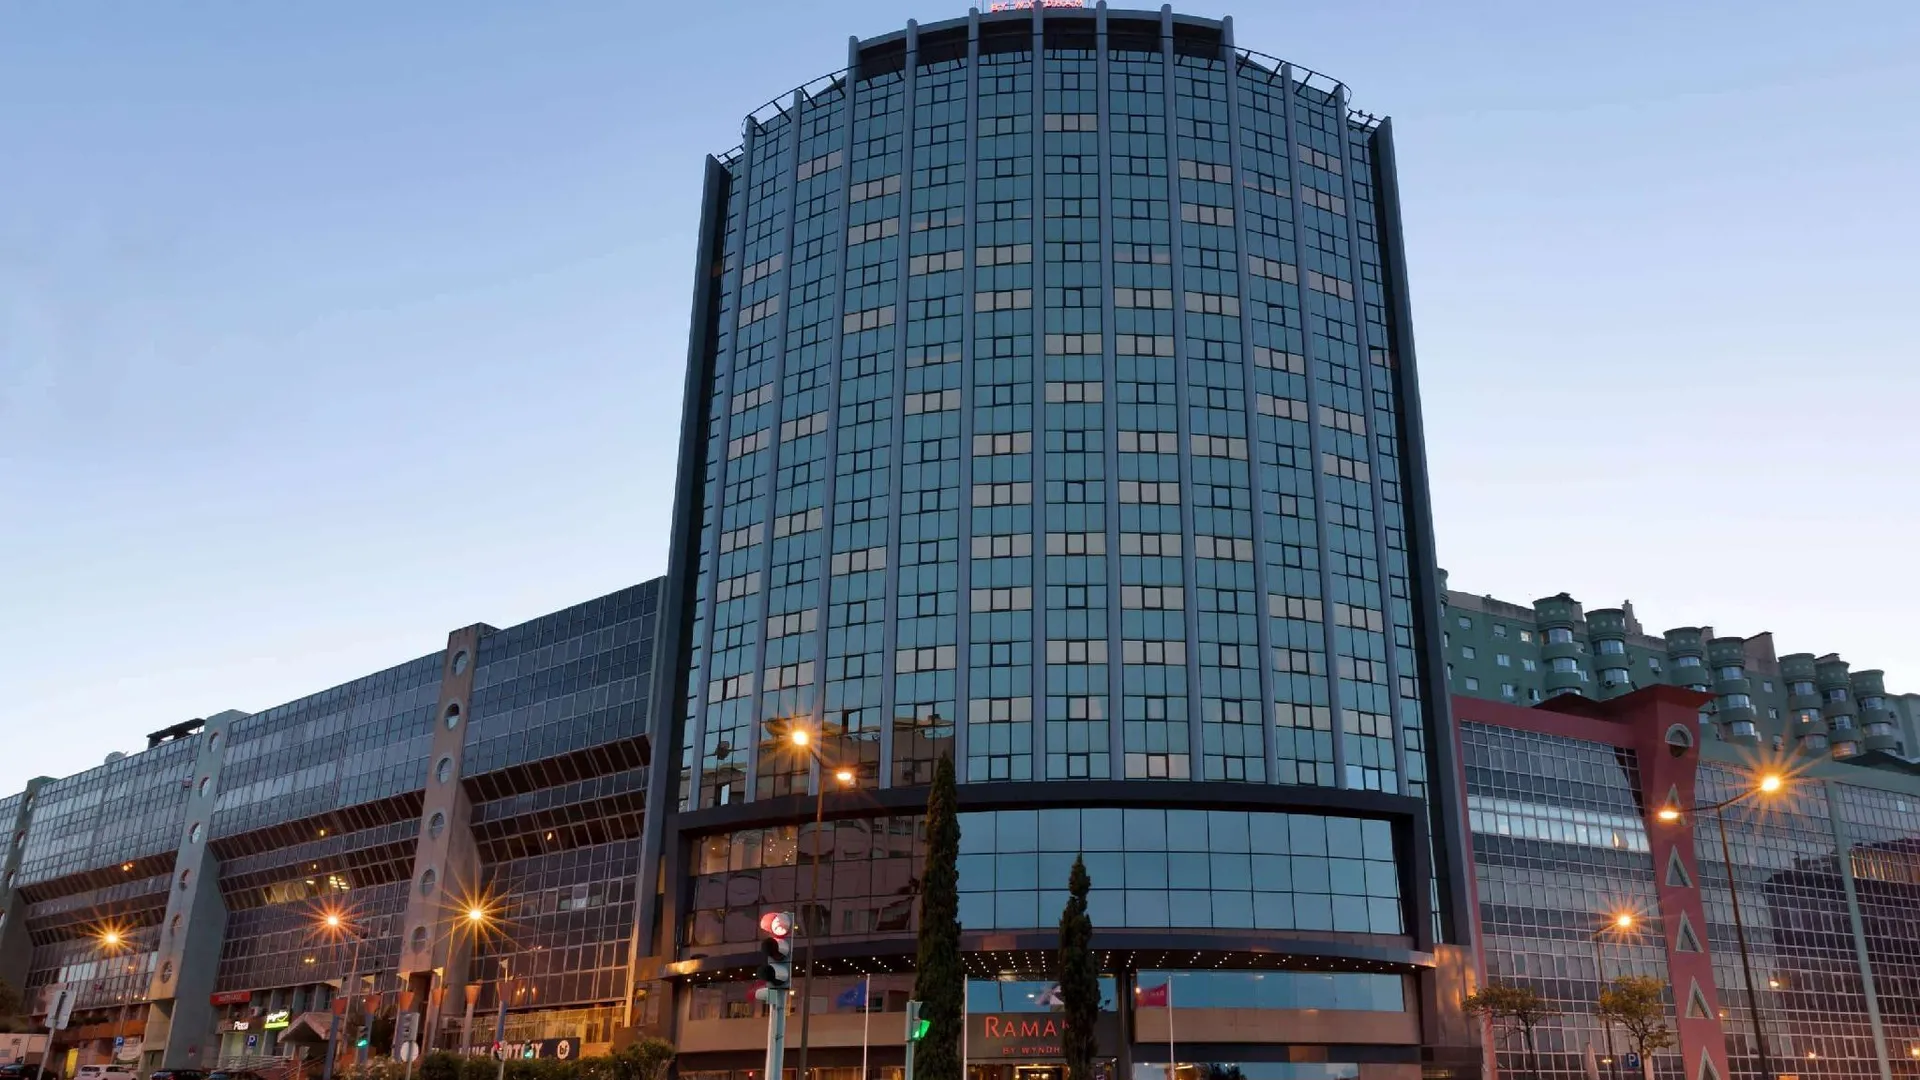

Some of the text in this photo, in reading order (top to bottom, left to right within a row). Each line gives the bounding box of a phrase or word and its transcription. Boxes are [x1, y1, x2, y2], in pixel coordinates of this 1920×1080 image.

[985, 1016, 1069, 1038] RAMA
[1002, 1046, 1016, 1055] BY
[1628, 1054, 1636, 1066] P
